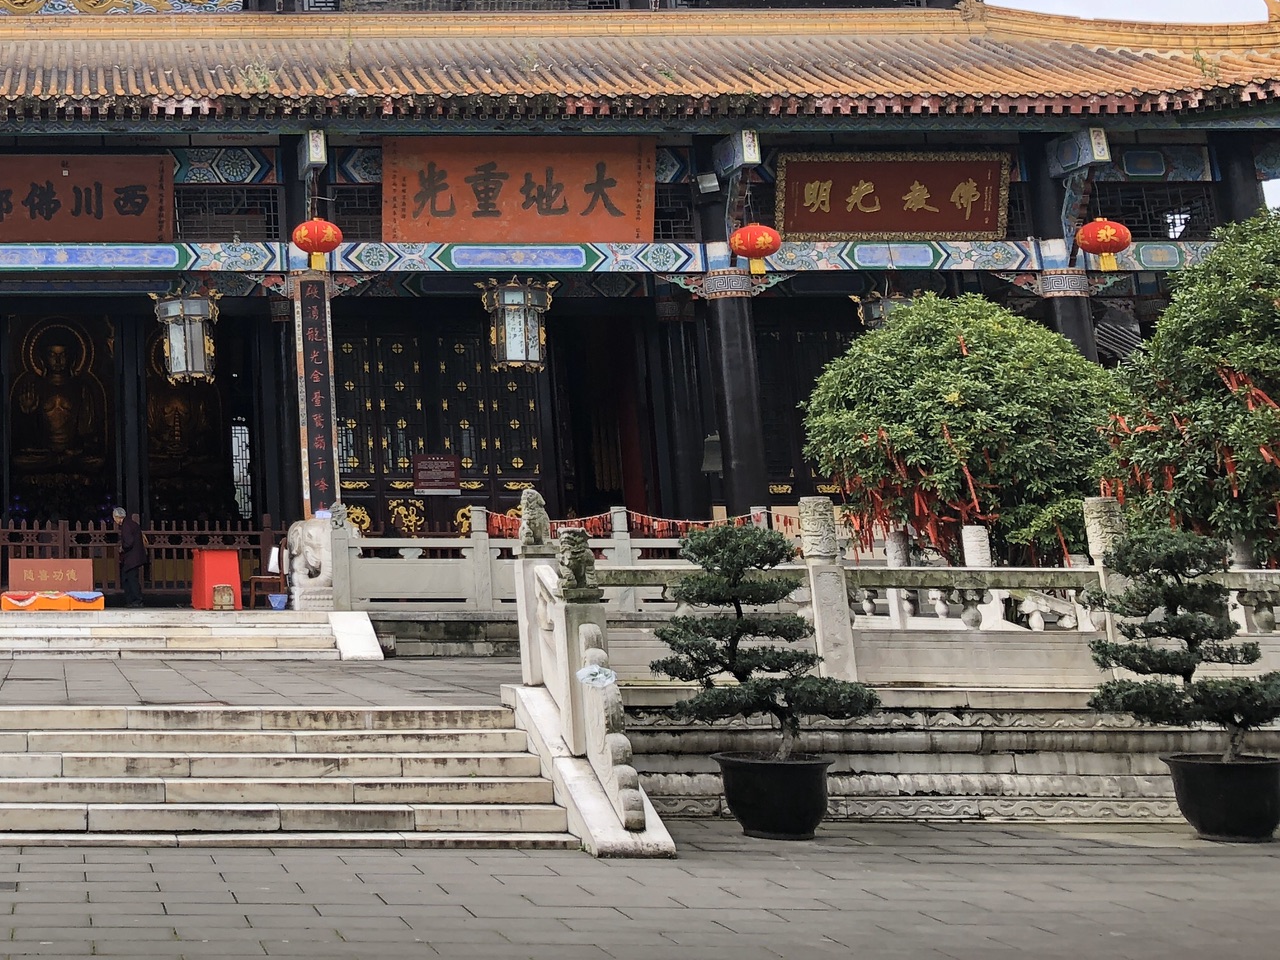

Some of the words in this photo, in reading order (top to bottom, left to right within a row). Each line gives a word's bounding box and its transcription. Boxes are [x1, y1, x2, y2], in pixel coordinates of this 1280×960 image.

[412, 161, 626, 219] 大地重光
[803, 178, 981, 221] 佛教光明
